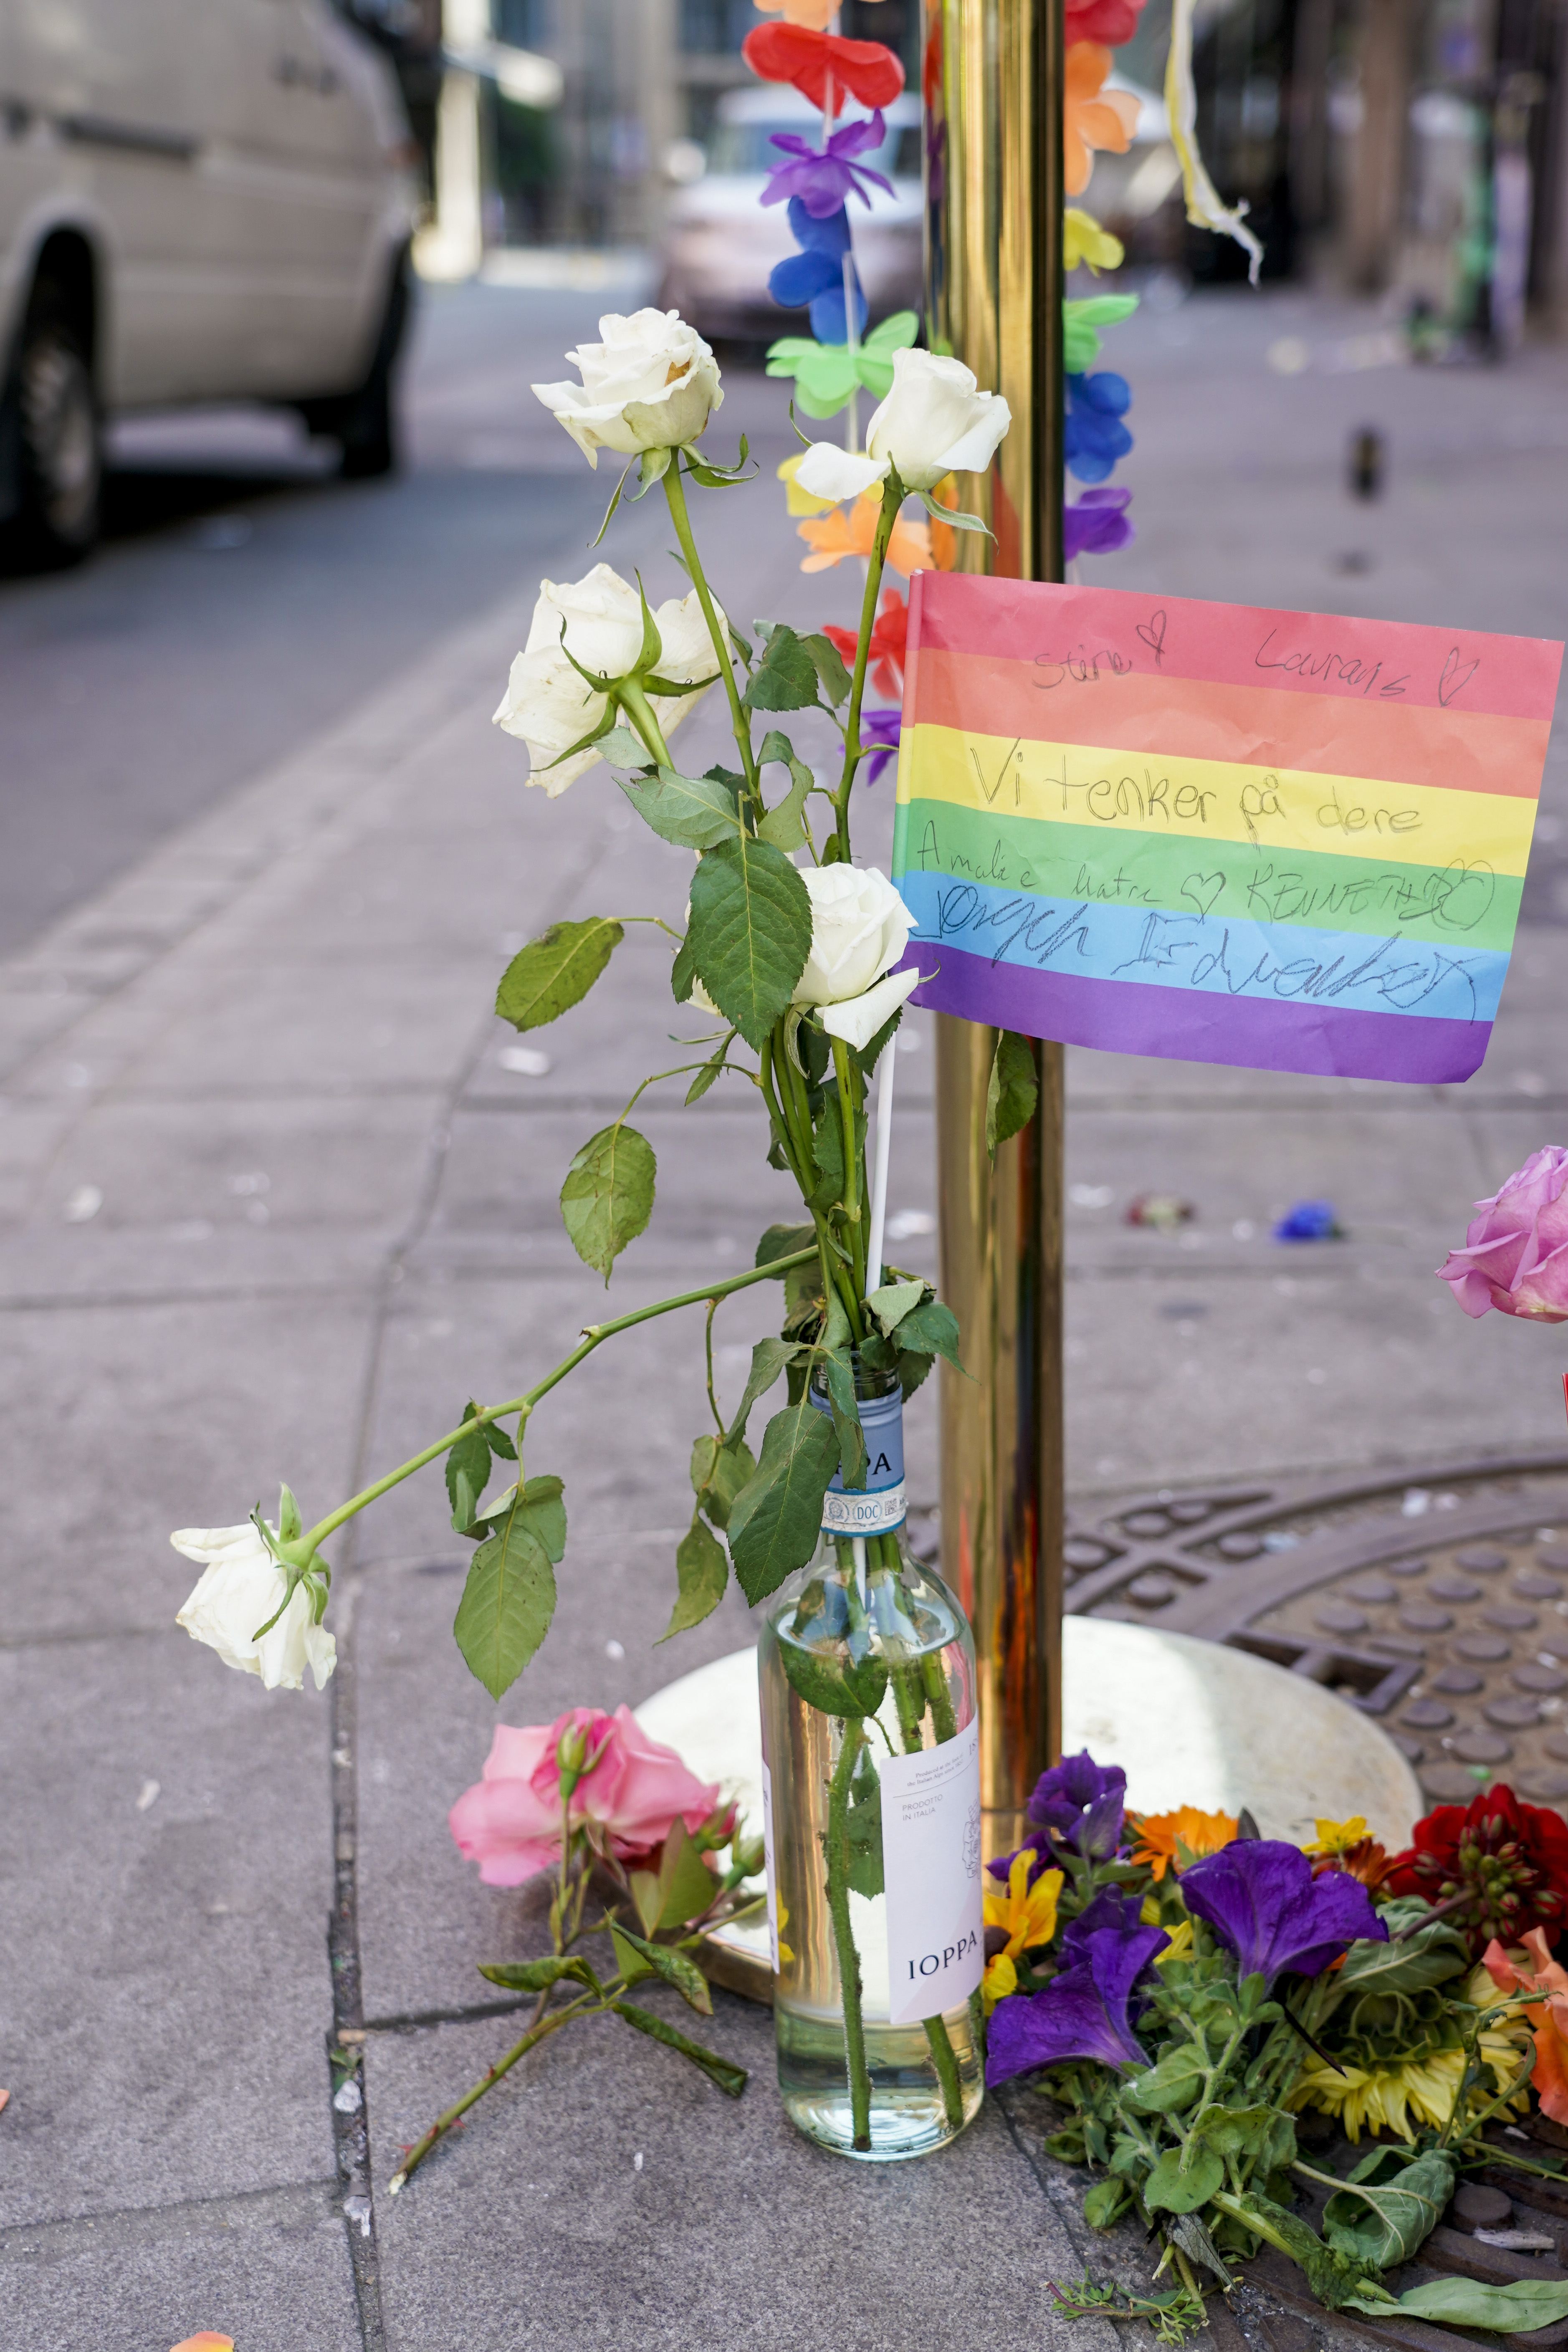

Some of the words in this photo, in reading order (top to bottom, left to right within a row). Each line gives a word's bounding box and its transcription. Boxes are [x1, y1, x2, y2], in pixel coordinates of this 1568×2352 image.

[970, 737, 1023, 807] Vi
[1043, 754, 1216, 824] tenker
[1239, 774, 1286, 856] på
[1316, 786, 1423, 835] dere
[857, 1505, 878, 1520] DOC
[916, 1766, 938, 1778] Produced
[917, 1776, 933, 1785] Italian
[933, 1771, 943, 1780] Alps
[902, 1794, 943, 1811] PRODOTTO
[914, 1807, 936, 1819] ITALIA
[908, 1930, 977, 1980] IOPPA
